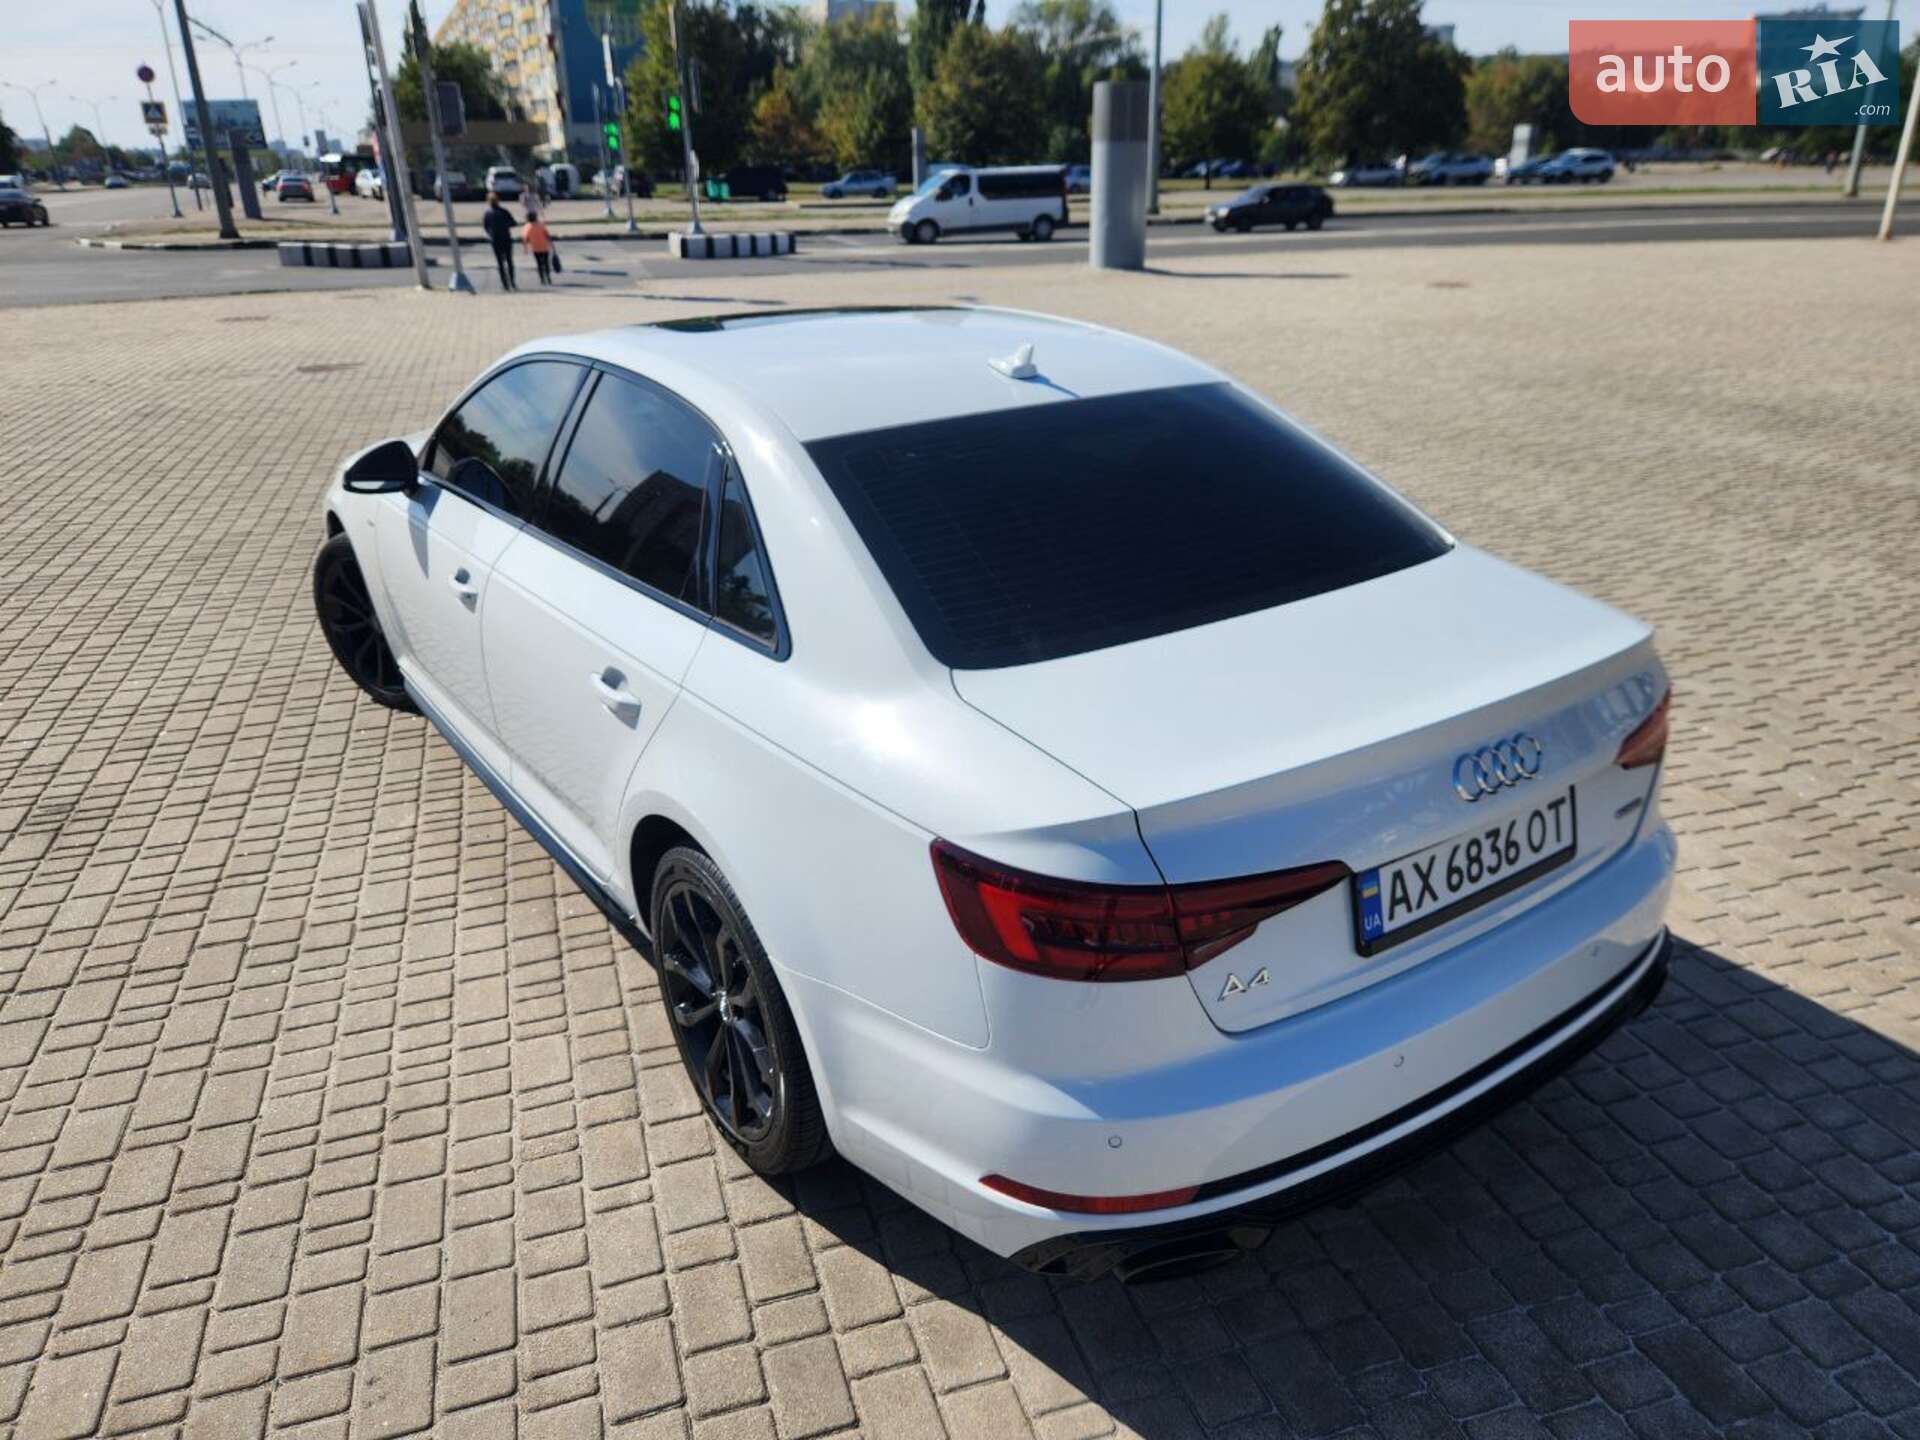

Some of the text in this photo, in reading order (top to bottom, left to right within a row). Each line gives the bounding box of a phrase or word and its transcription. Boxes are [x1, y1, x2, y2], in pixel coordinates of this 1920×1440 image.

[1388, 796, 1566, 921] AX 6836 OT
[1364, 917, 1382, 931] UA
[1217, 966, 1269, 1002] A4
